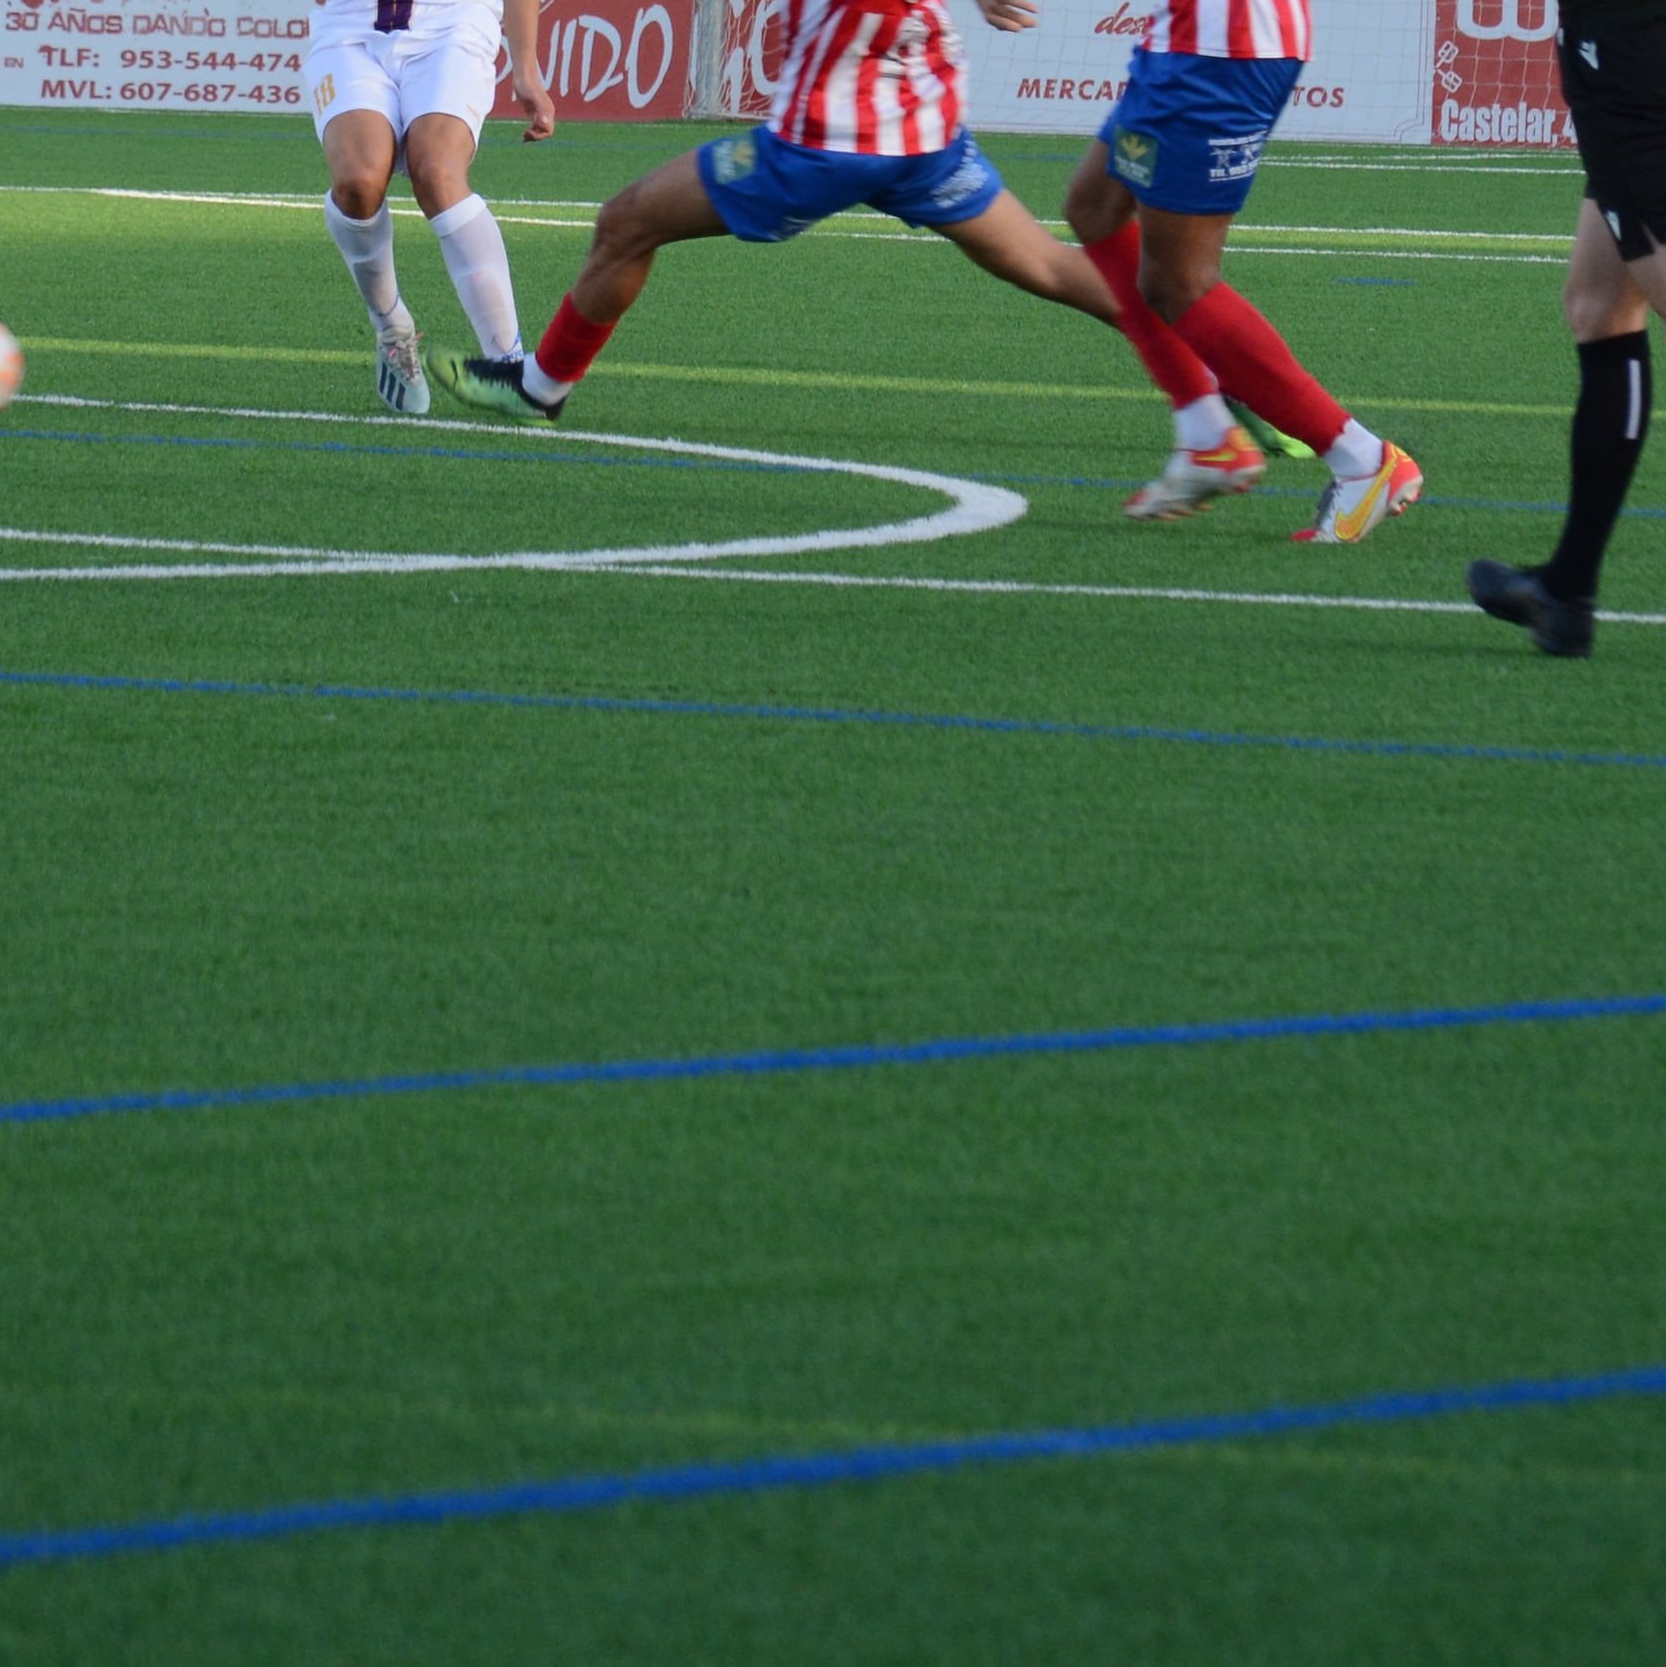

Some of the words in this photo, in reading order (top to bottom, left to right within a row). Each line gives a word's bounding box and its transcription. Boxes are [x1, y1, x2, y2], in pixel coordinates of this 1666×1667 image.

[6, 11, 39, 31] 30
[48, 8, 123, 34] AÑOS
[133, 14, 226, 38] DANDO
[237, 17, 310, 39] COLO
[40, 45, 100, 68] TLF:
[120, 49, 301, 72] 953-544-474
[41, 80, 112, 101] MVL:
[120, 82, 301, 104] 607-687-436
[1292, 86, 1345, 108] TOS
[1441, 98, 1558, 146] Castelar,
